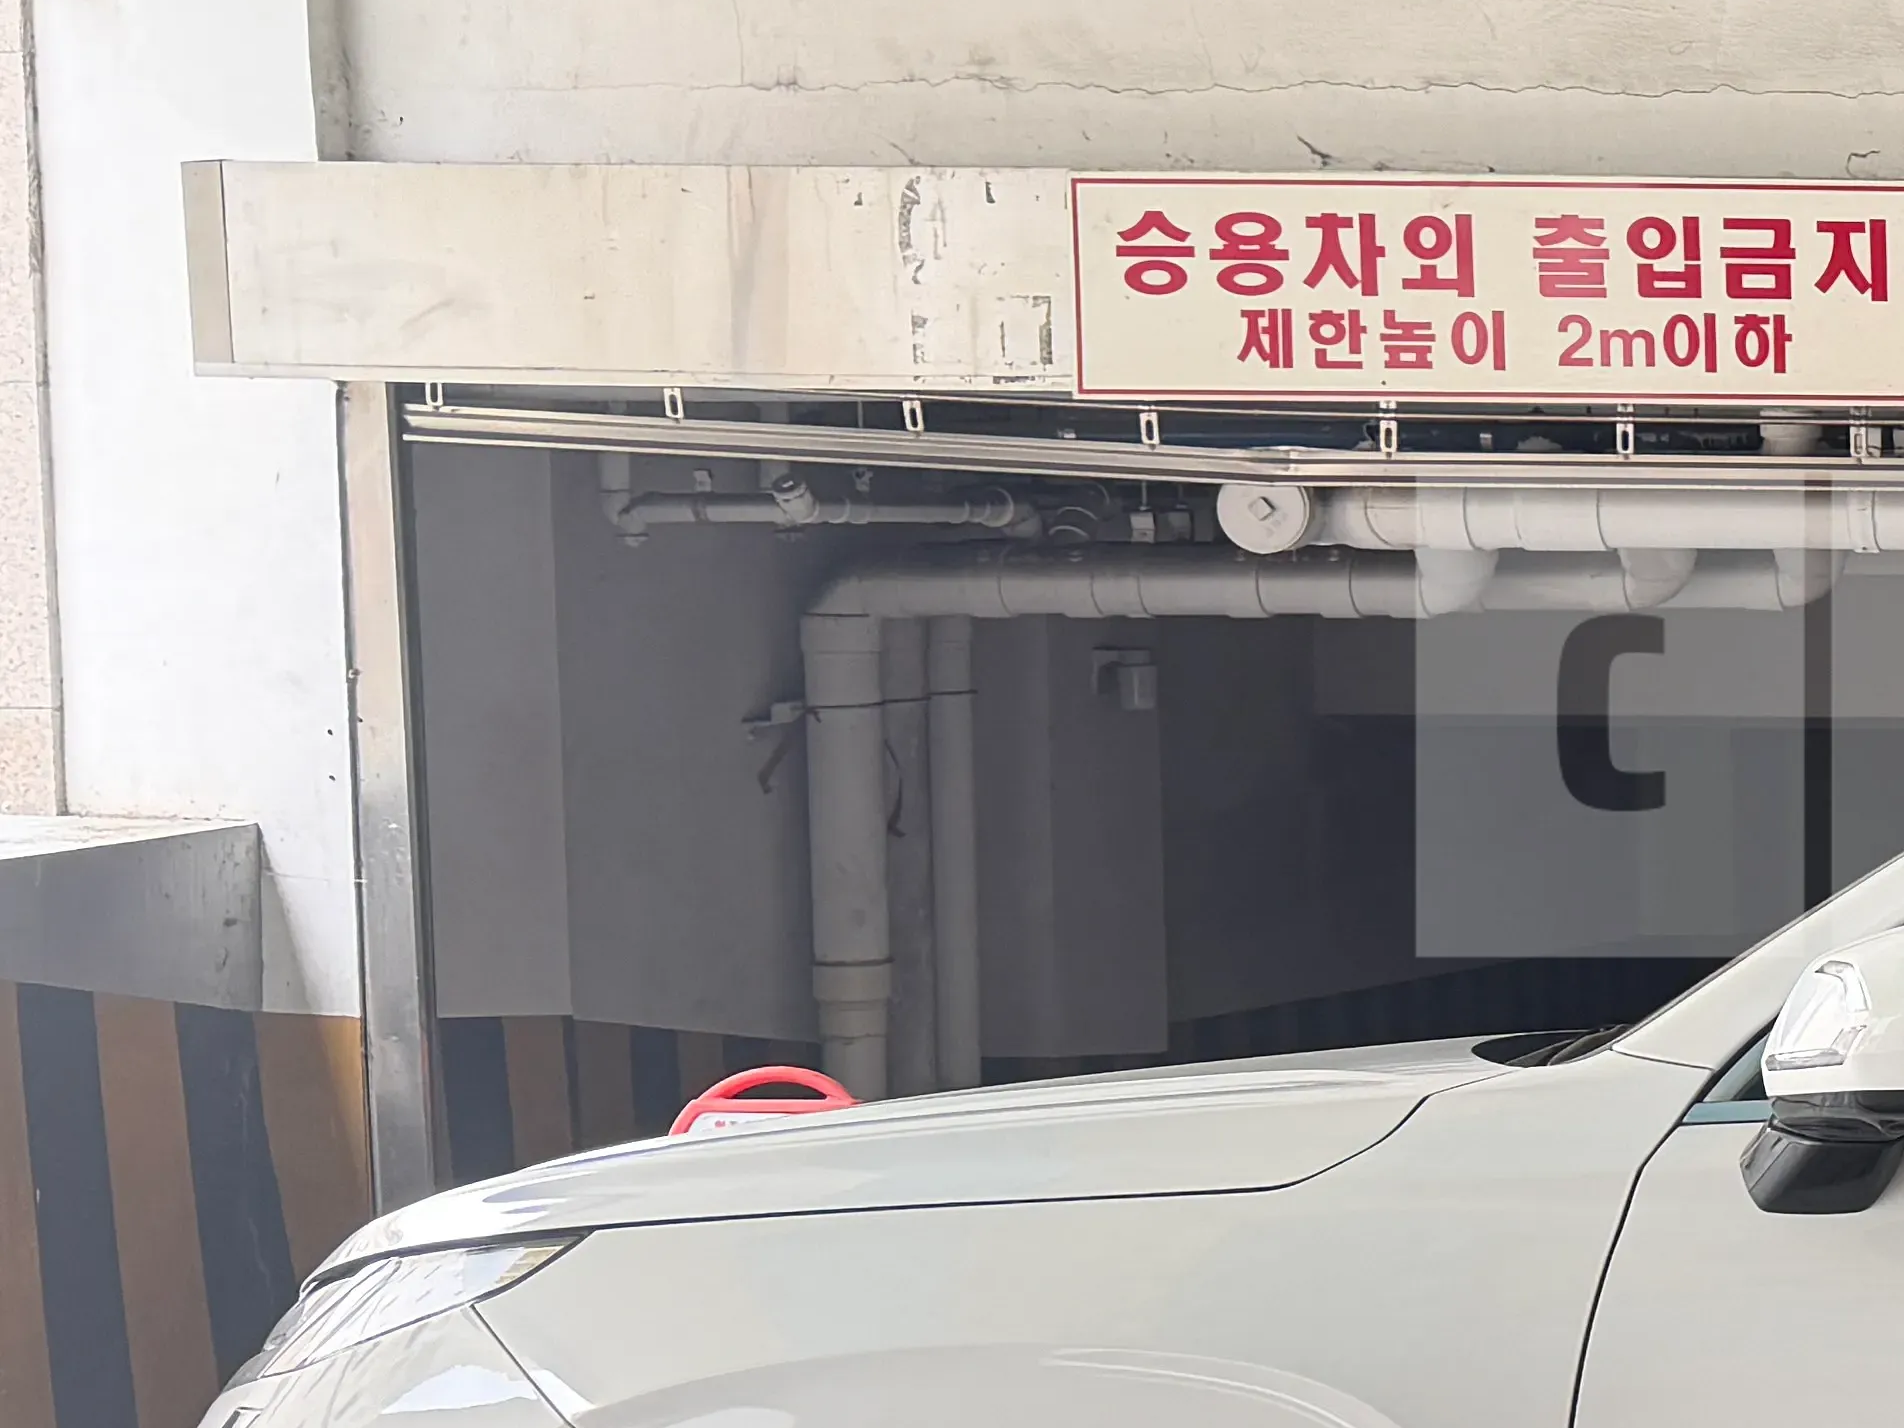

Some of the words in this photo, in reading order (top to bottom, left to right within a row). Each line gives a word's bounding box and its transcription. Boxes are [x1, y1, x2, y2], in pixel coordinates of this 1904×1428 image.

[1114, 209, 1476, 298] 승용차외
[1531, 213, 1889, 302] 출입금지
[1236, 307, 1507, 371] 제한높이
[1556, 311, 1793, 373] 2m이하
